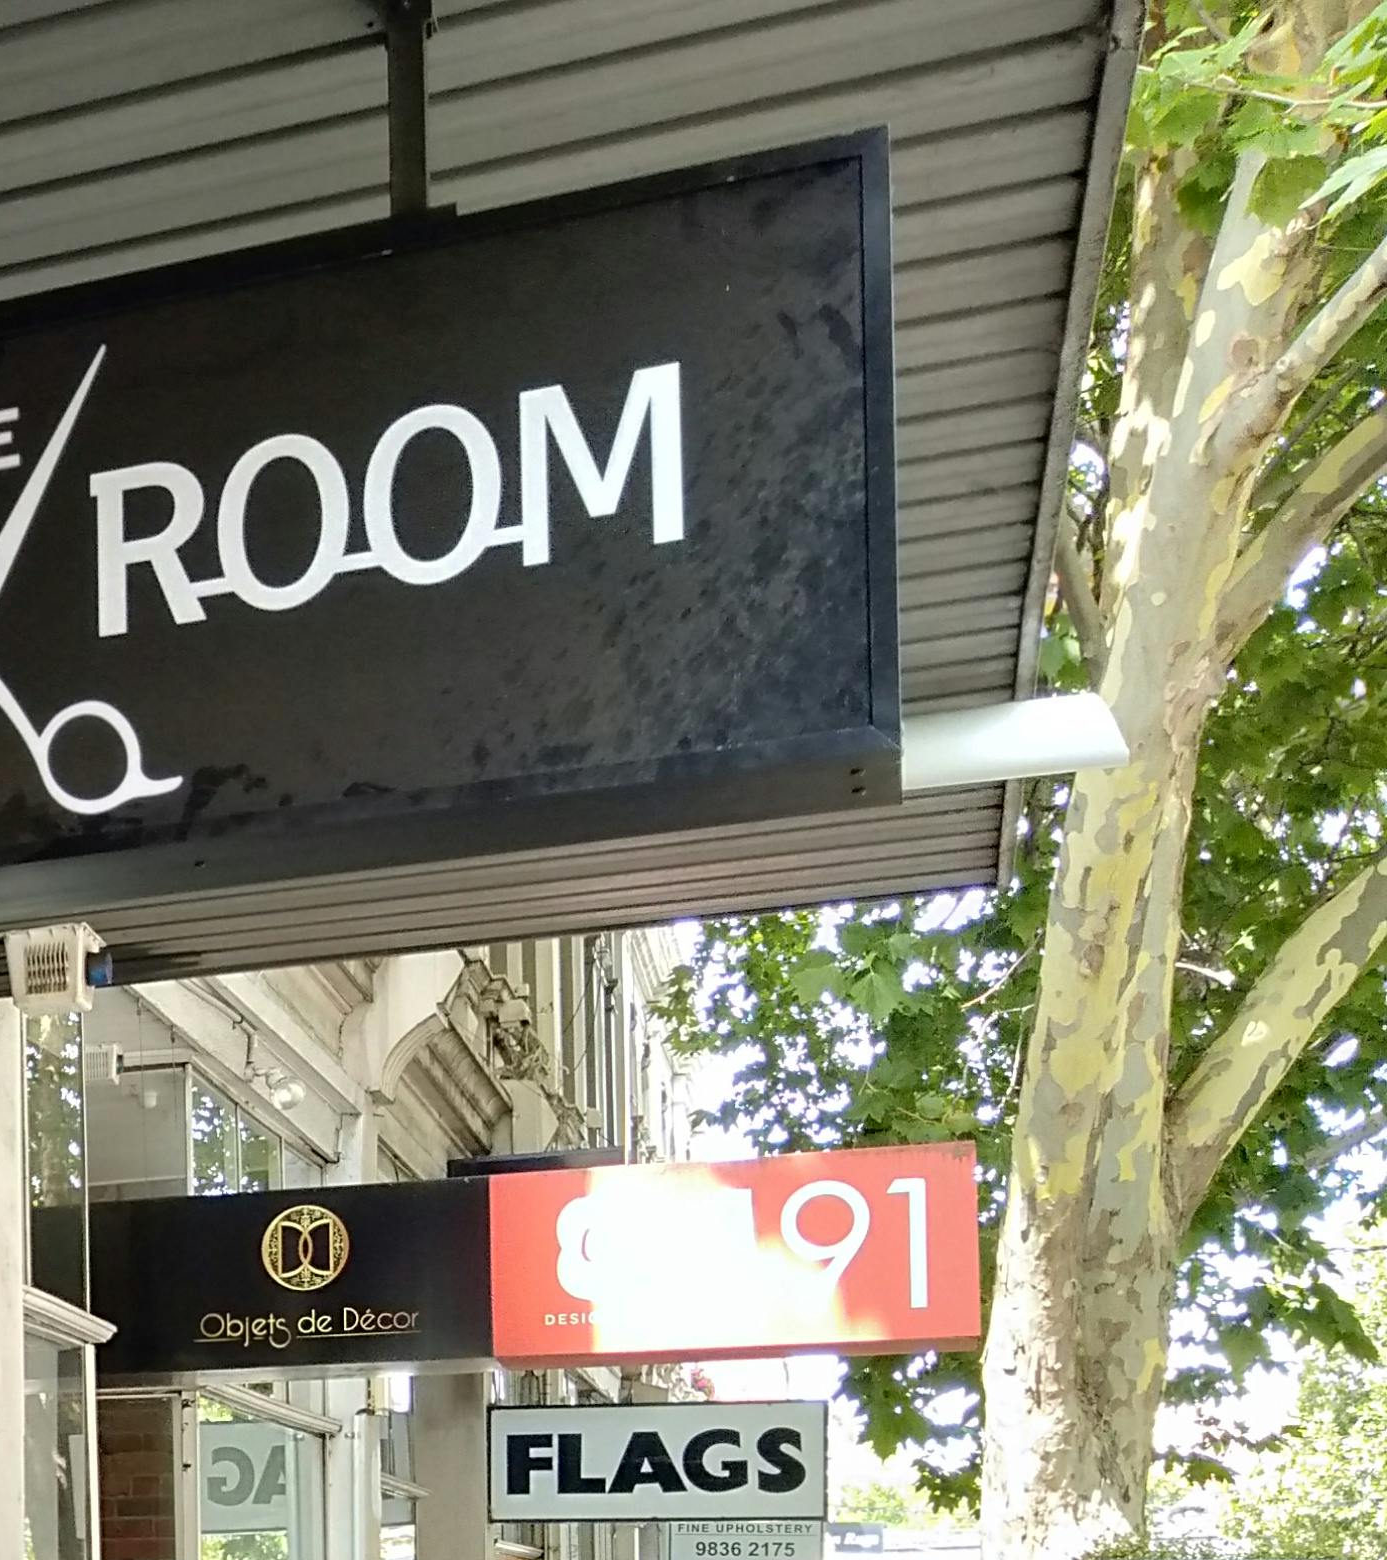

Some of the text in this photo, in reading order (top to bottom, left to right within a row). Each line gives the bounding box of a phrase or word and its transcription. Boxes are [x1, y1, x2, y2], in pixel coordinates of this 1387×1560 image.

[89, 361, 685, 638] ROOM
[200, 1306, 420, 1348] Objets de Décor
[507, 1427, 806, 1495] FLAGS
[677, 1523, 813, 1534] FINE UPHOLSTERY
[695, 1541, 796, 1557] 9836 2175
